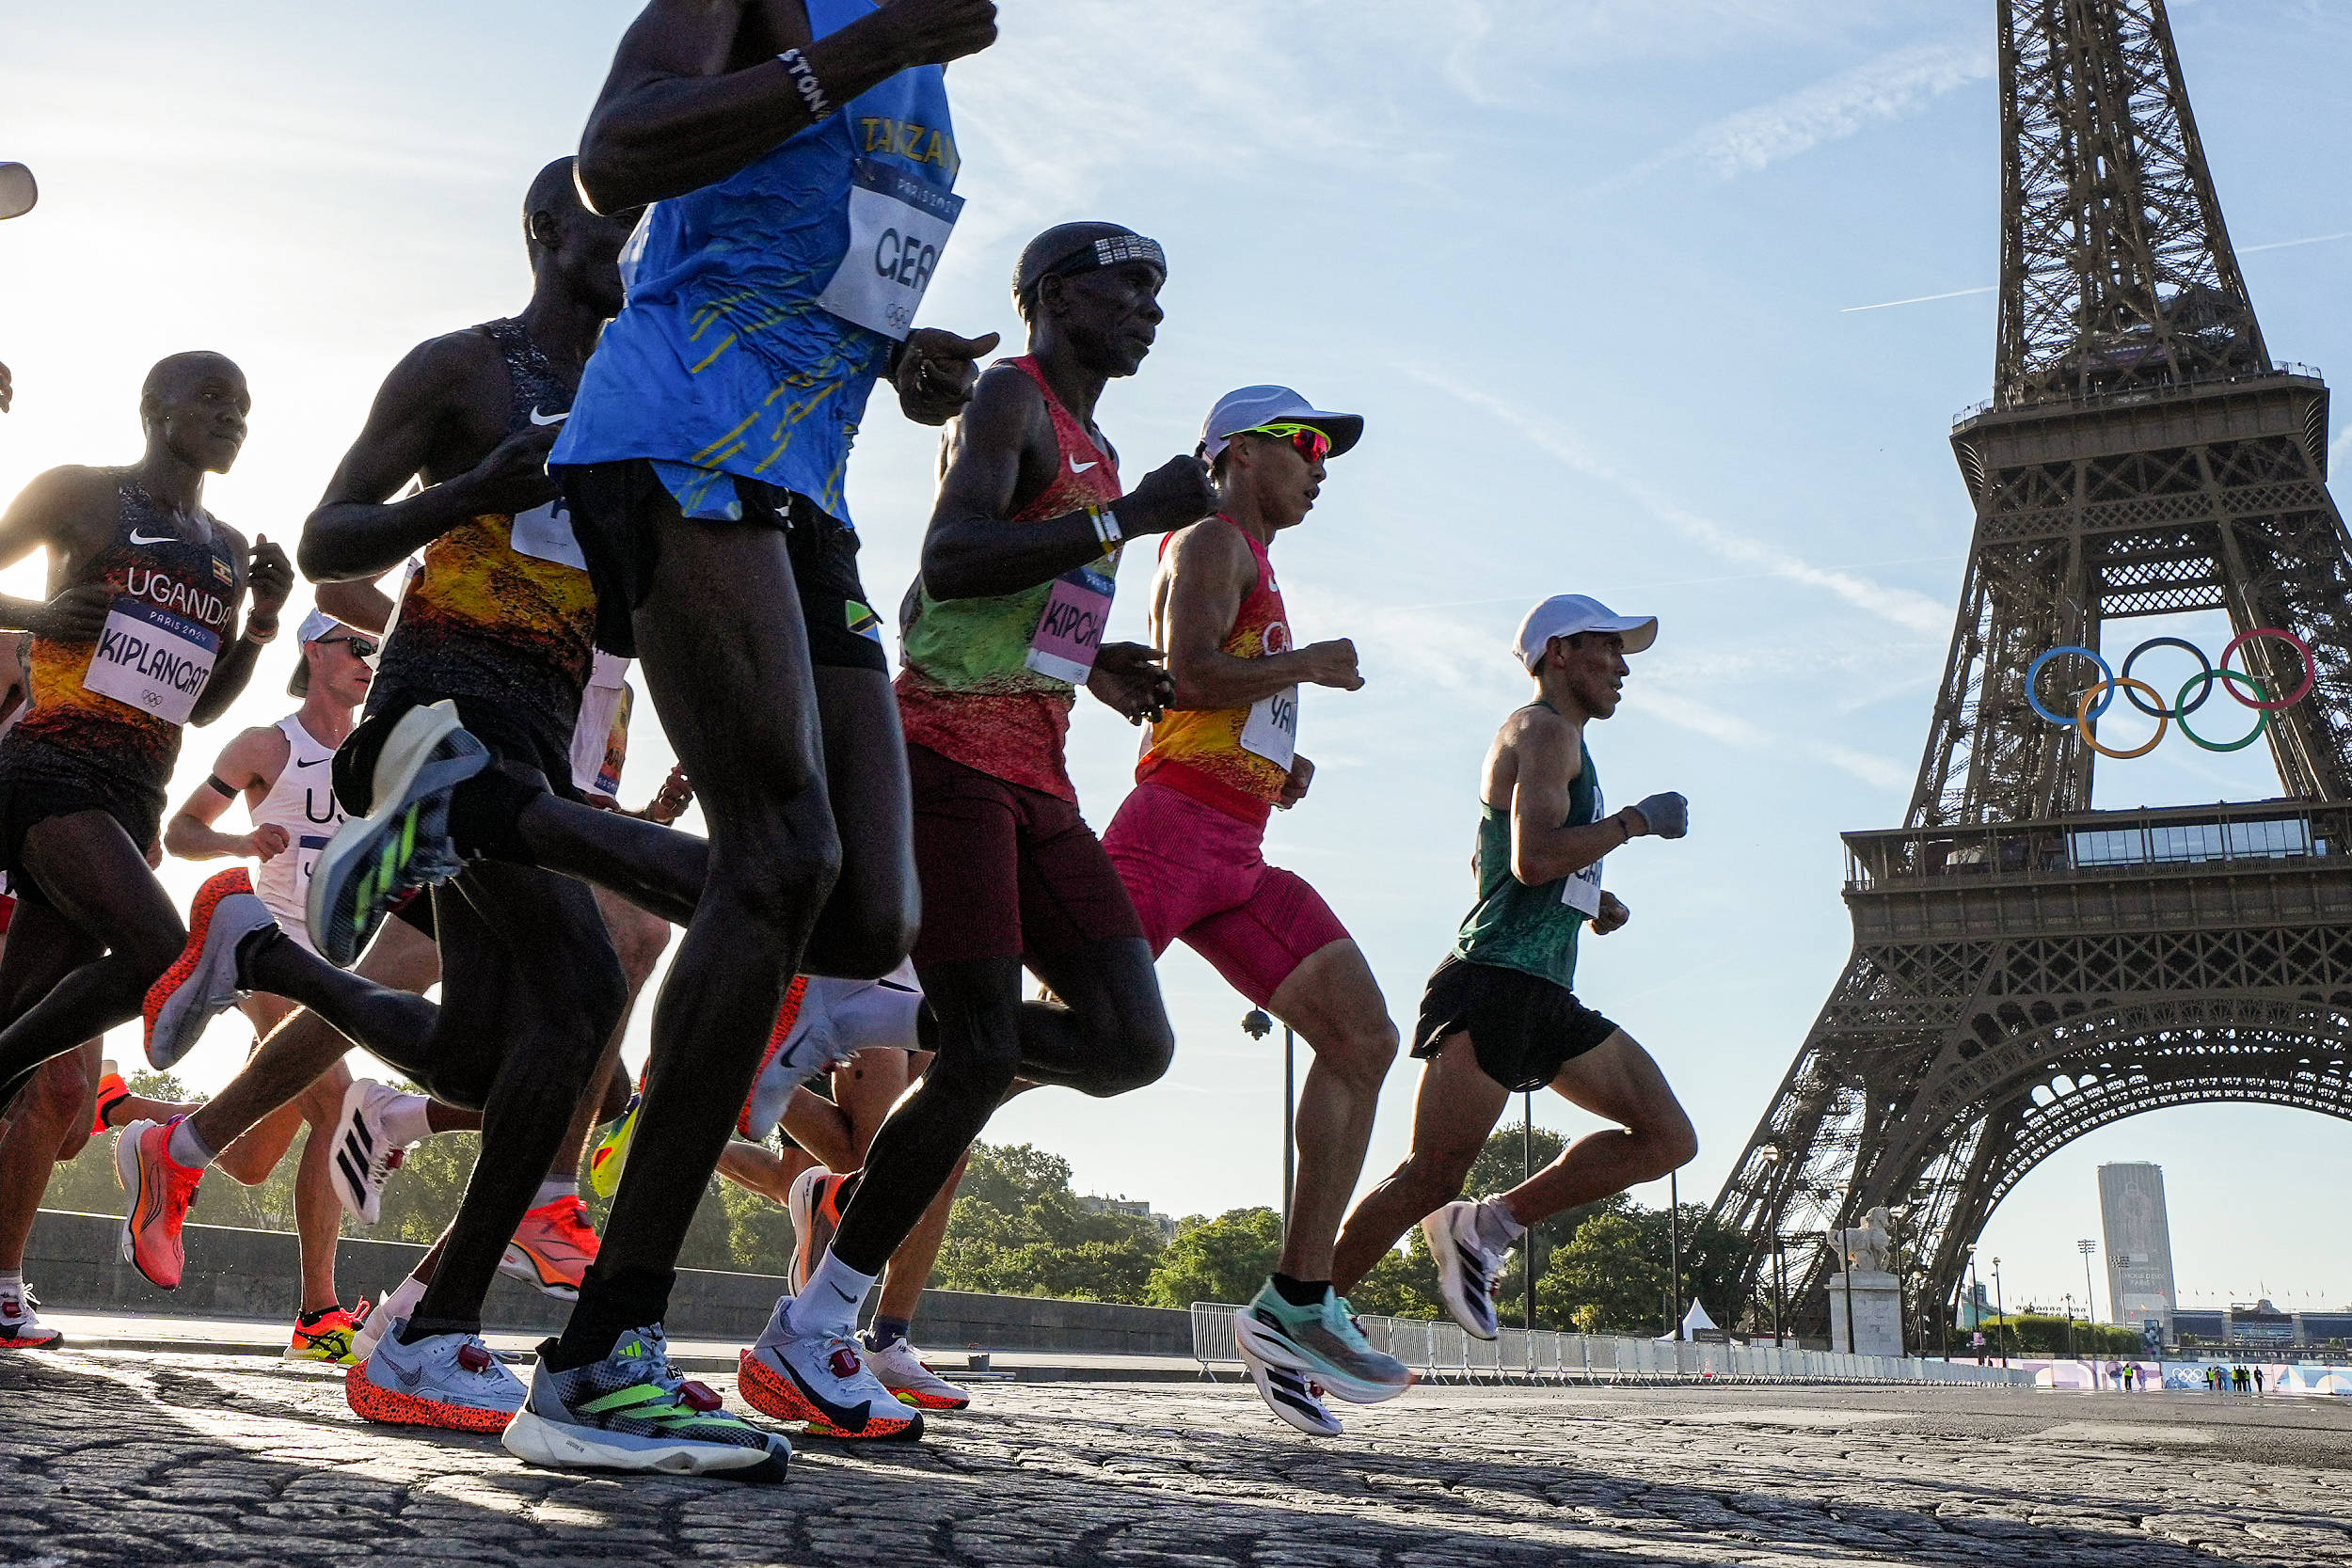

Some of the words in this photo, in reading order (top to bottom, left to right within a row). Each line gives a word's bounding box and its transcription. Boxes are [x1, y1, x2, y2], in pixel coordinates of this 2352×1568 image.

[127, 566, 231, 632] UGANDA
[149, 611, 181, 630] PARIS
[183, 625, 207, 641] 2024
[97, 628, 210, 697] KIPLANGAT
